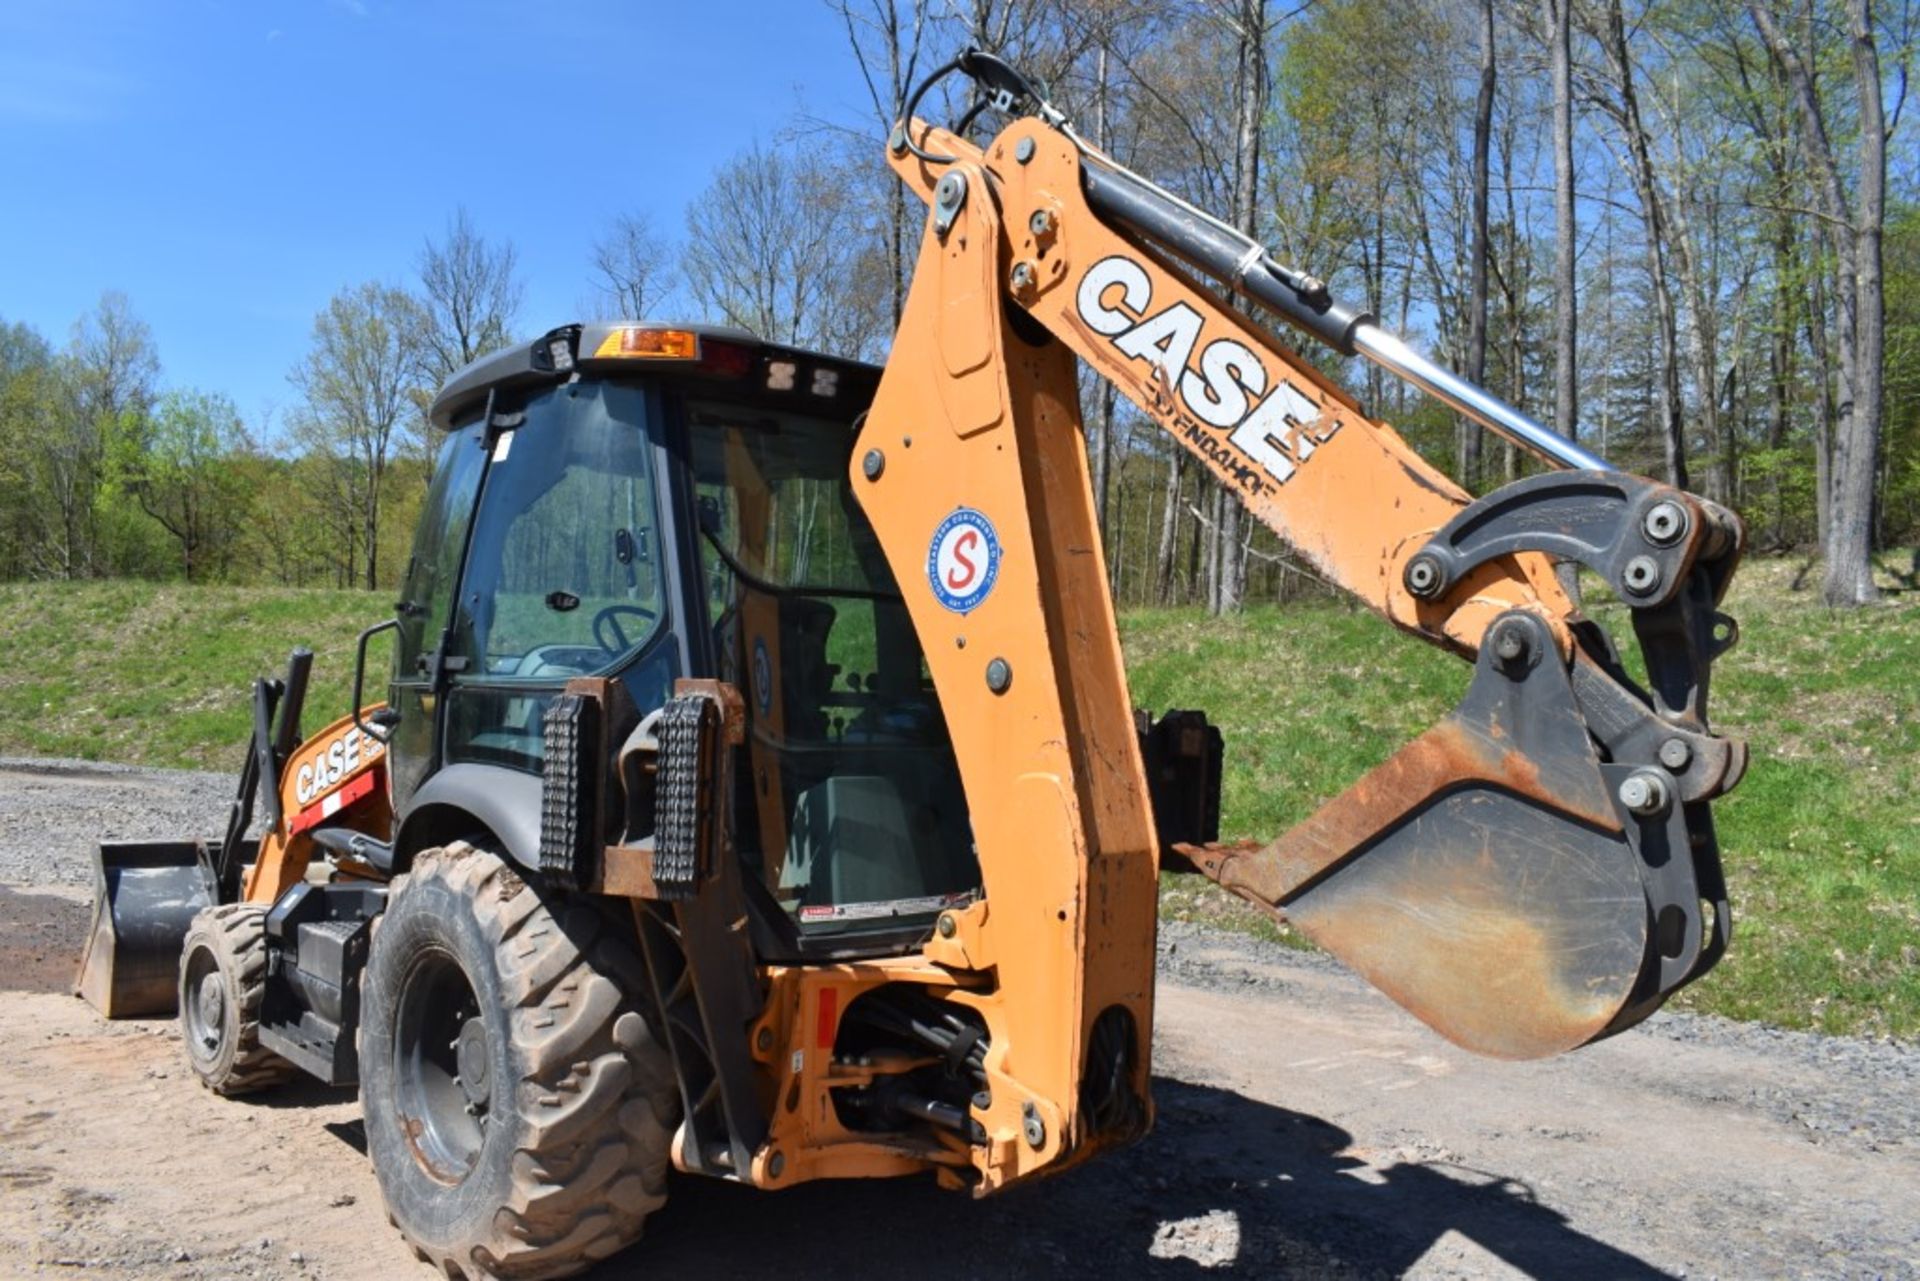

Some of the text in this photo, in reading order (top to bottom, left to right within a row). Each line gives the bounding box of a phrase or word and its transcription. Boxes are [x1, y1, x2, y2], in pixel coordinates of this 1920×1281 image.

[1076, 255, 1343, 485] CASE
[948, 531, 978, 589] S
[296, 726, 360, 804] CASE
